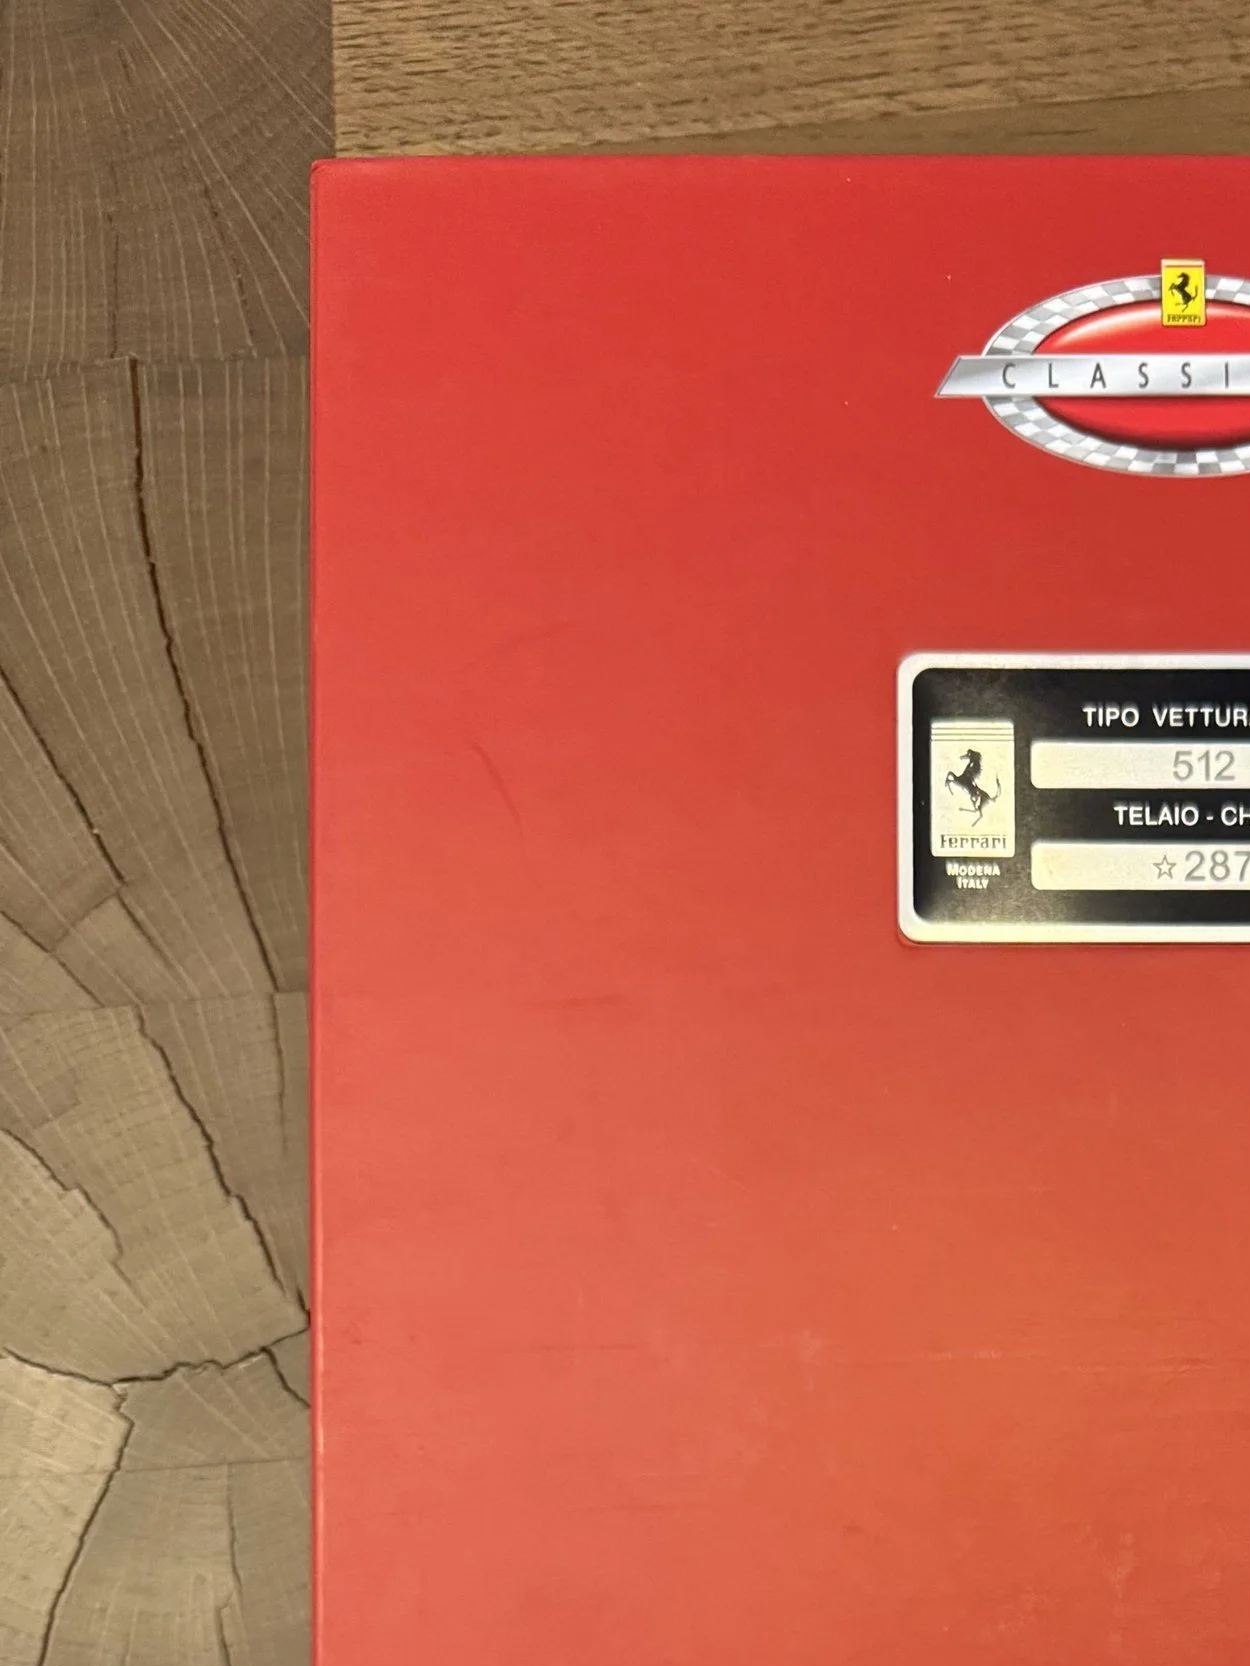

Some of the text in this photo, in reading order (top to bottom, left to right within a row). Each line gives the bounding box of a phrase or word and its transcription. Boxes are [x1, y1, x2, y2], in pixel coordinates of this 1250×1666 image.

[1083, 707, 1139, 728] TIPO
[1172, 750, 1235, 781] 512
[1114, 805, 1199, 826] TELAIO
[940, 834, 1007, 850] Ferrari
